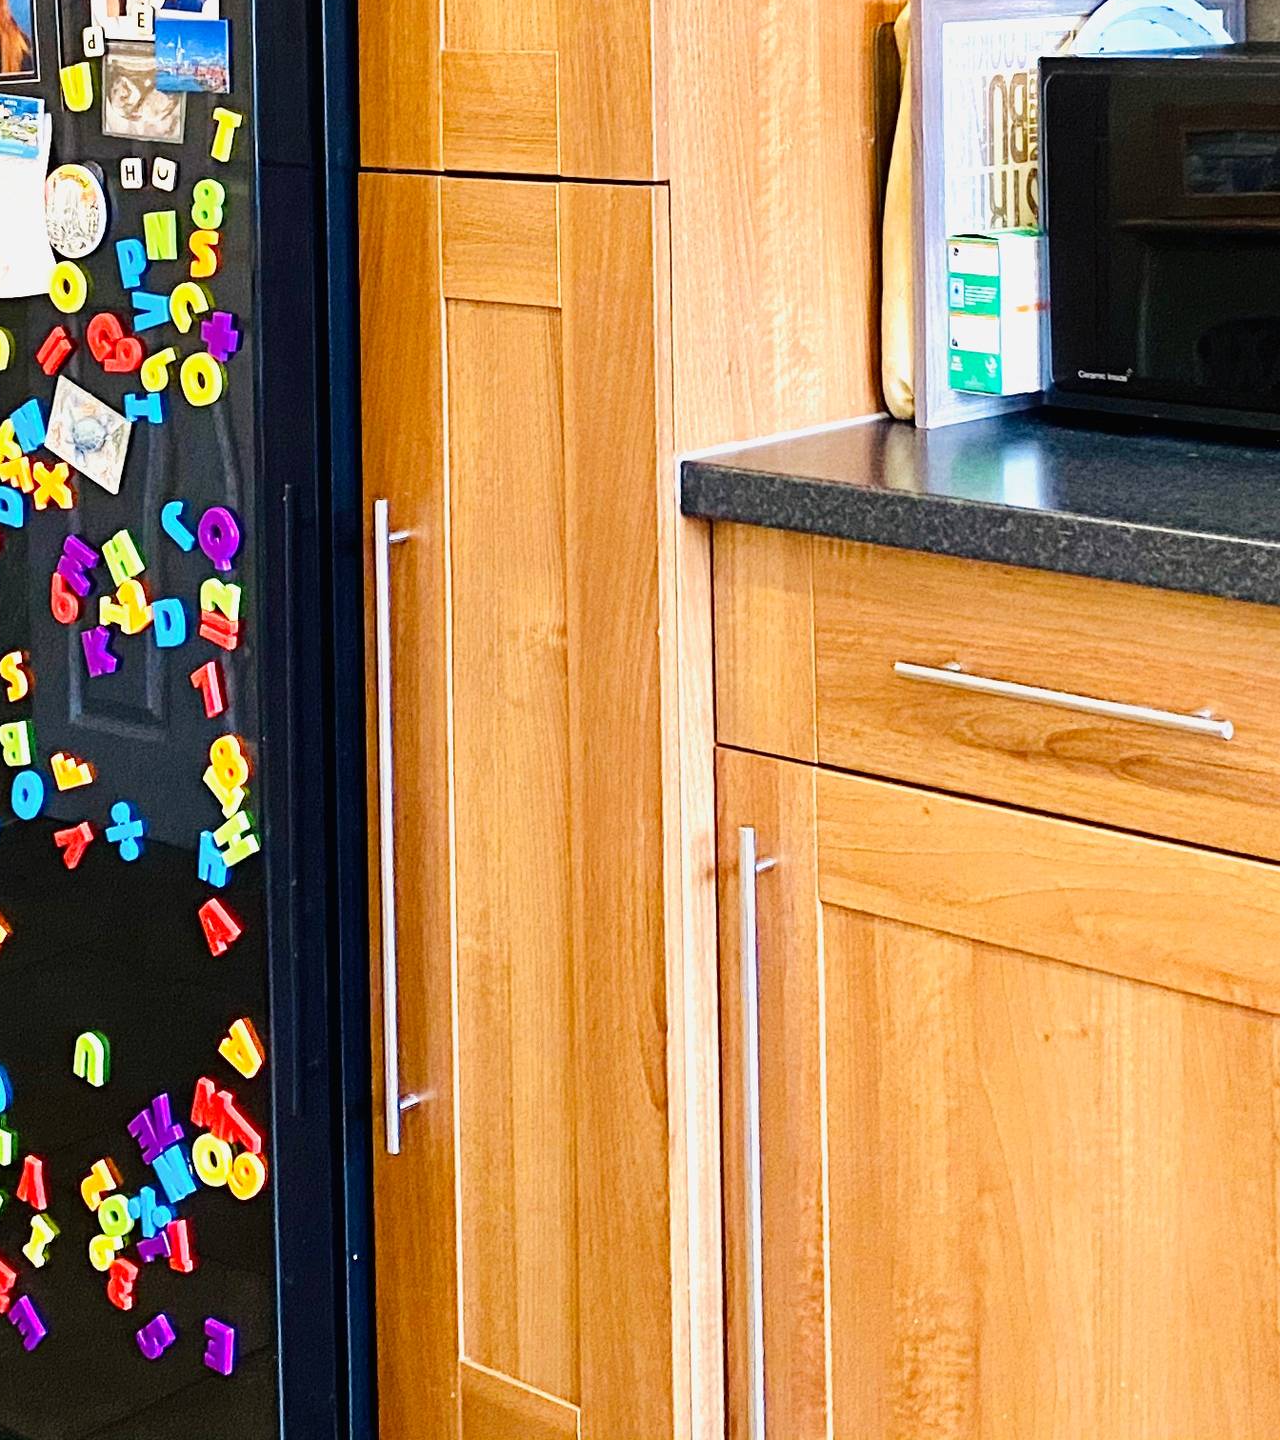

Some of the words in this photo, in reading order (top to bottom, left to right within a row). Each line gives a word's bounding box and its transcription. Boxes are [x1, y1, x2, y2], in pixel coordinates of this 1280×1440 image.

[137, 13, 145, 28] E
[211, 107, 242, 162] T
[125, 165, 135, 180] H
[192, 179, 225, 230] 8
[33, 462, 73, 510] X
[151, 599, 186, 647] D
[198, 898, 242, 957] A
